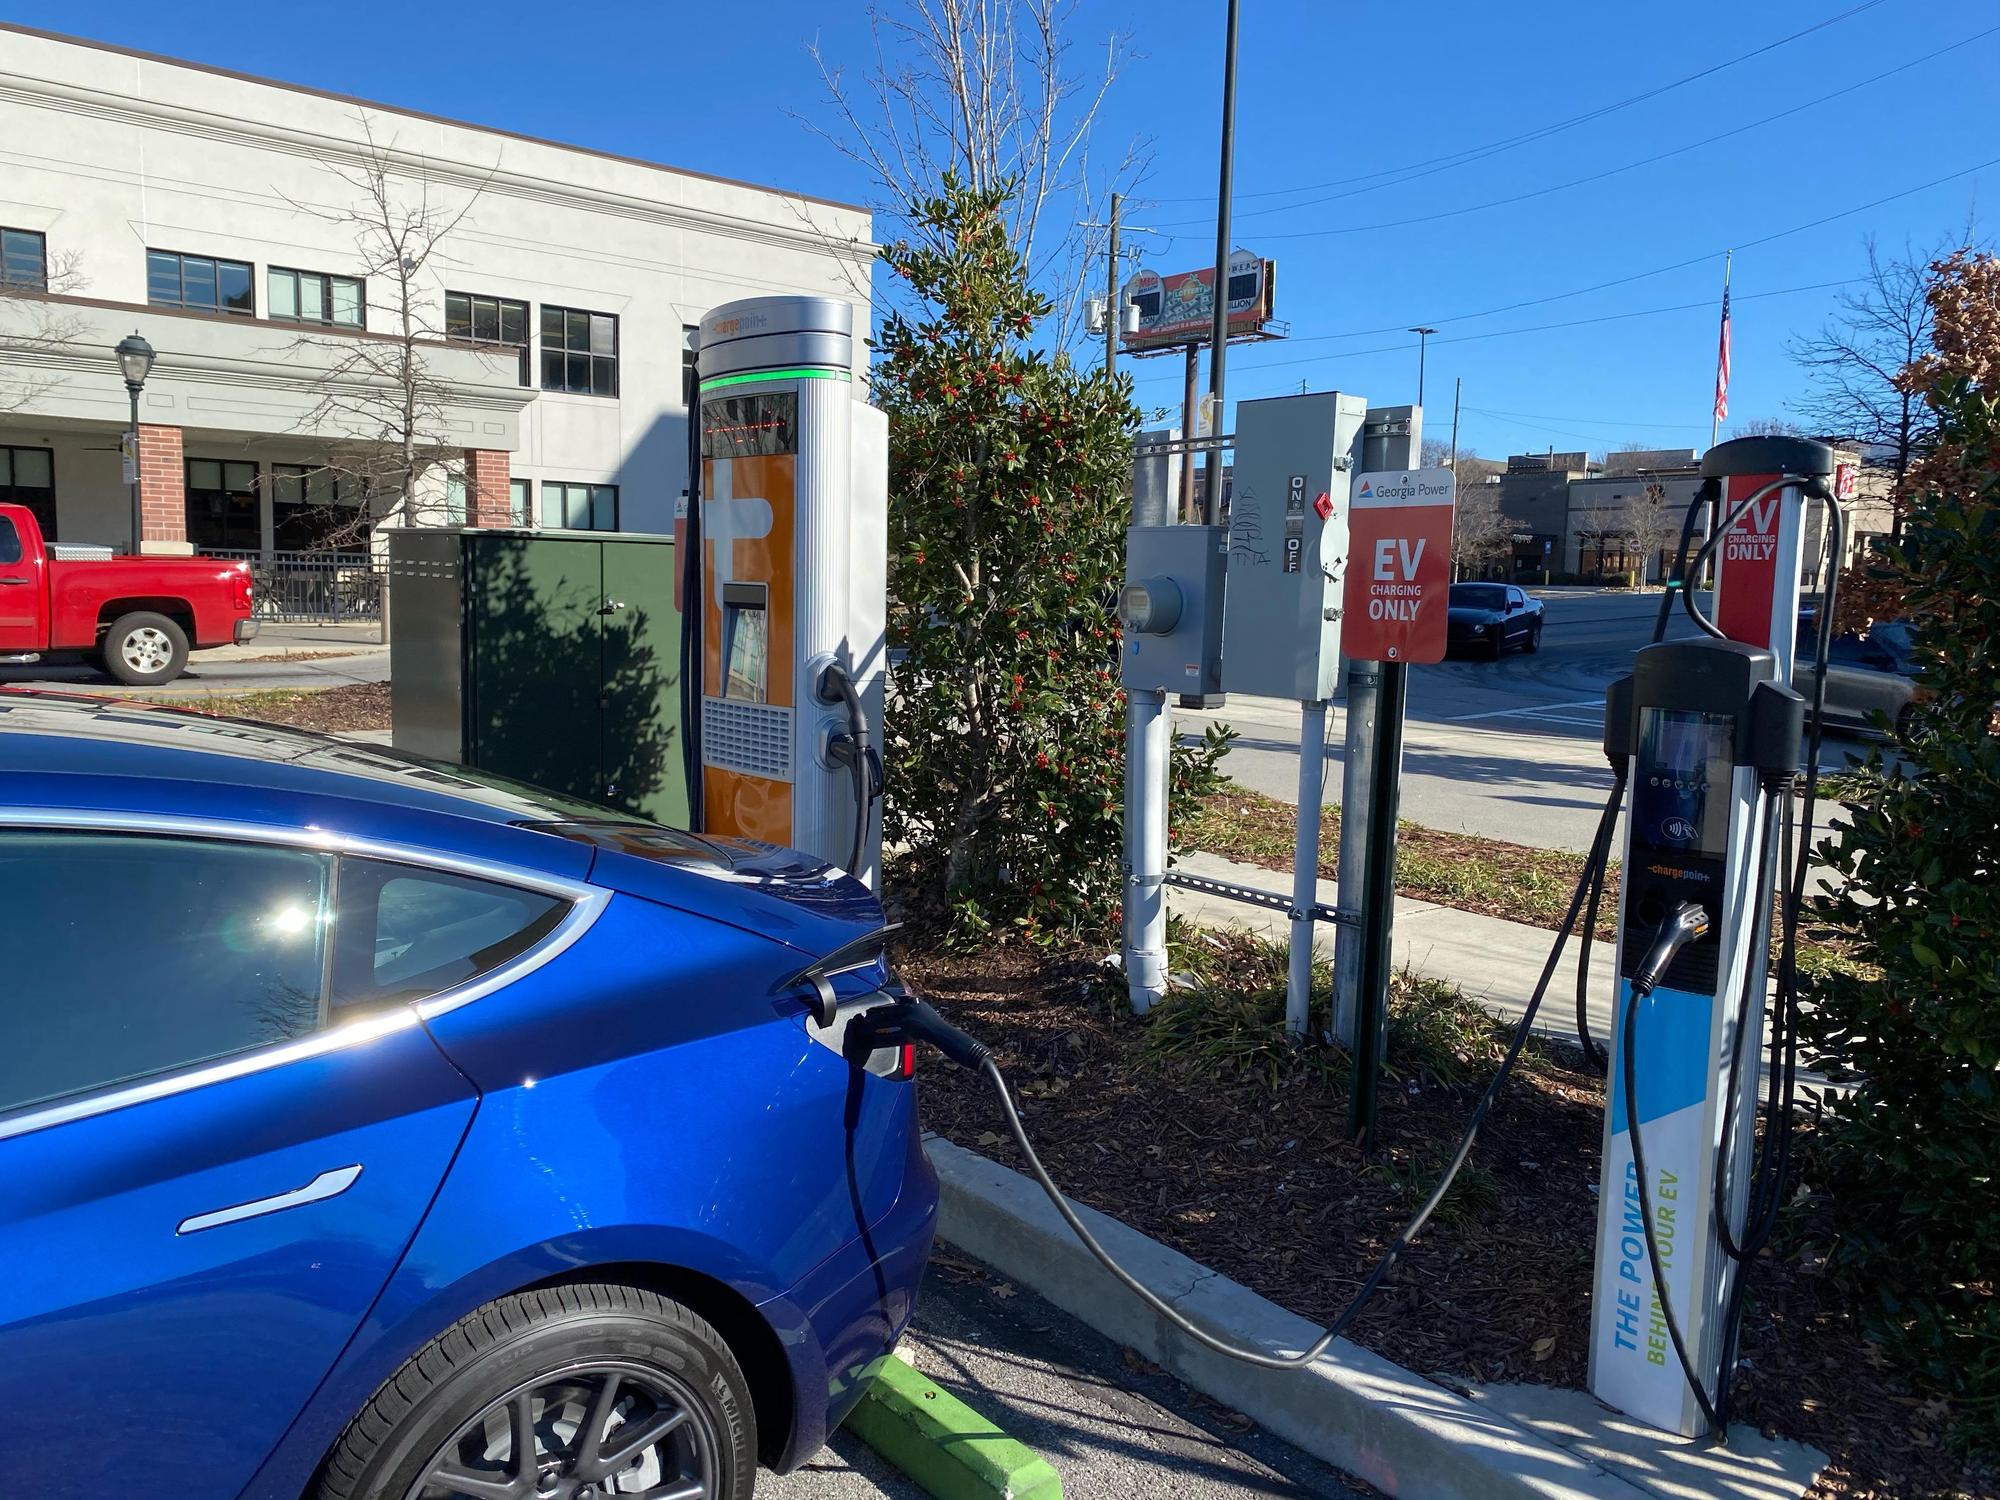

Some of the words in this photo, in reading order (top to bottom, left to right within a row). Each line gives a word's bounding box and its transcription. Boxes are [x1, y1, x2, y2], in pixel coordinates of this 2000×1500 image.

[1376, 484, 1416, 500] Georgia
[1418, 483, 1449, 496] Power
[1729, 499, 1778, 535] EV
[1727, 543, 1775, 561] ONLY
[1728, 534, 1776, 544] CHARGING
[1373, 538, 1427, 582] EV
[1370, 584, 1422, 597] CHARGING
[1368, 598, 1421, 621] ONLY
[1659, 1168, 1678, 1201] EV
[1655, 1206, 1676, 1269] YOUR
[1614, 1288, 1640, 1351] THE
[723, 1397, 746, 1496] MICHELIN
